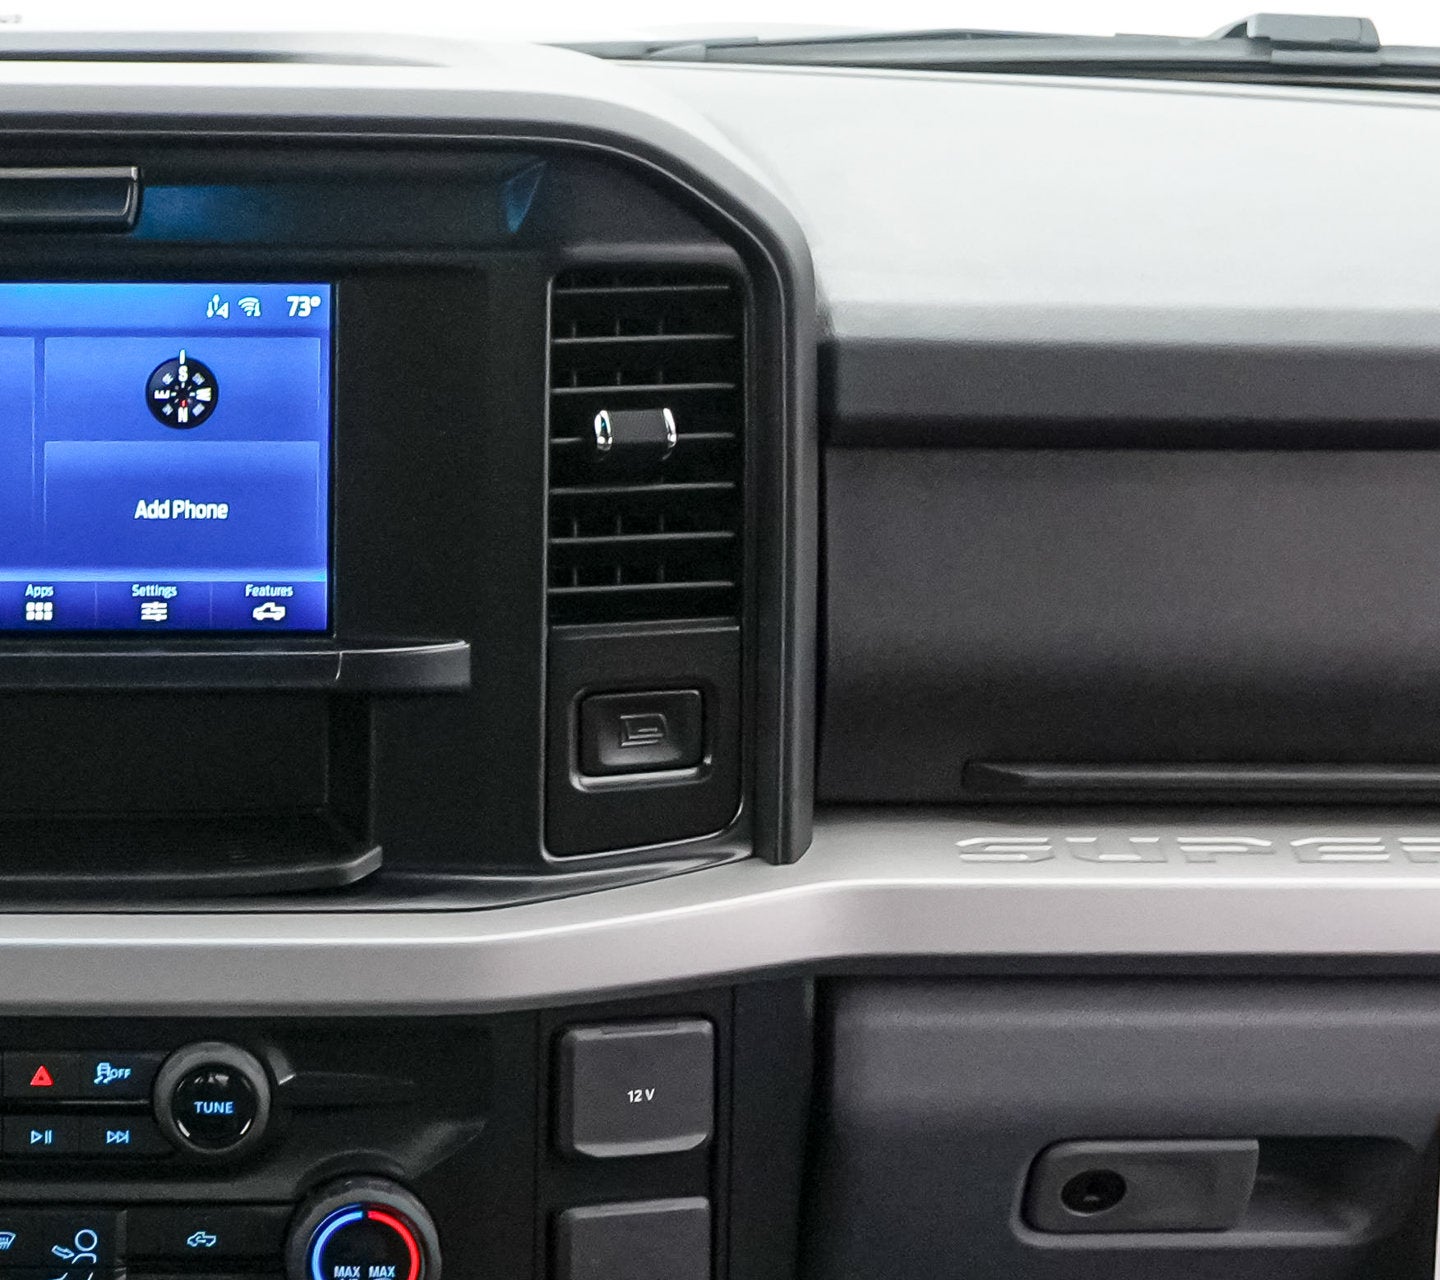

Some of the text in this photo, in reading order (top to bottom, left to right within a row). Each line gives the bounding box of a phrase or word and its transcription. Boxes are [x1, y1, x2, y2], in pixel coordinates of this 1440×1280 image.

[134, 501, 228, 519] Add Phone
[26, 583, 54, 600] Apps
[132, 583, 177, 600] Settings
[245, 583, 293, 598] Features
[194, 1100, 234, 1114] TUNE
[334, 1265, 361, 1278] MAX
[369, 1265, 396, 1278] MAX
